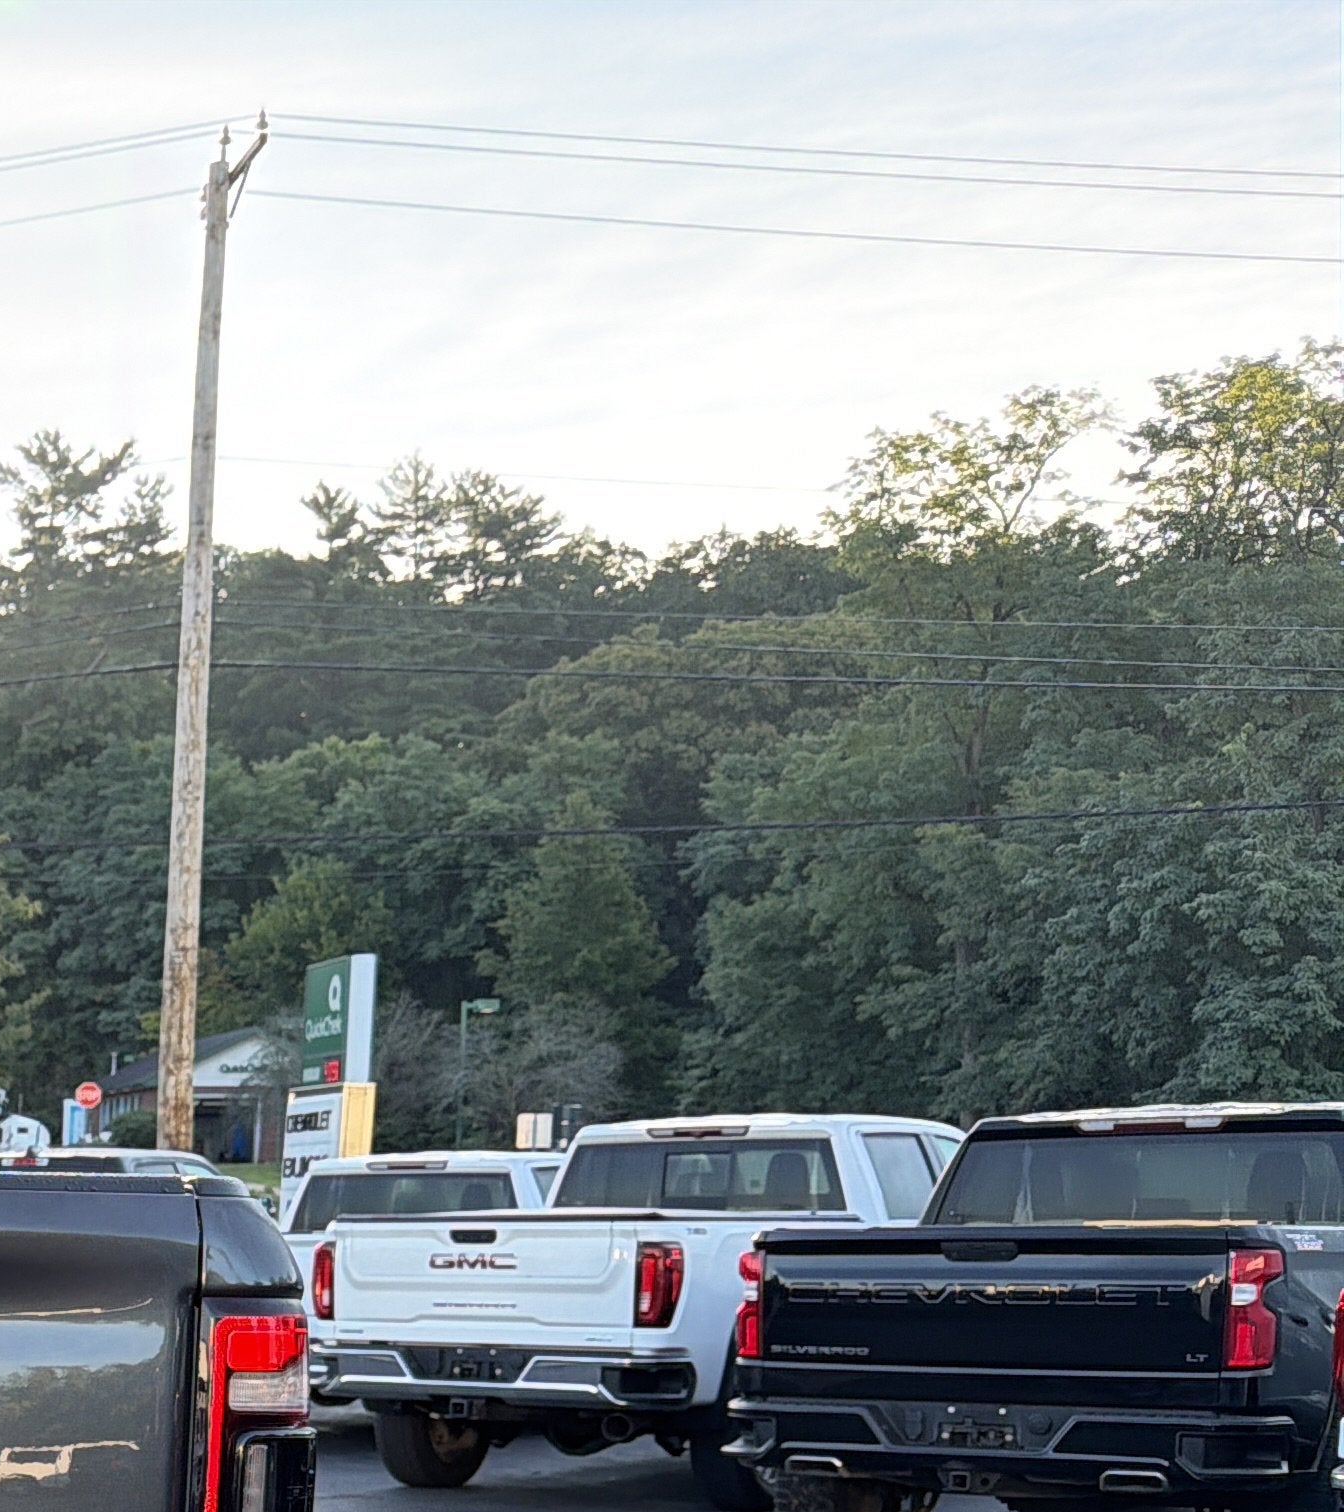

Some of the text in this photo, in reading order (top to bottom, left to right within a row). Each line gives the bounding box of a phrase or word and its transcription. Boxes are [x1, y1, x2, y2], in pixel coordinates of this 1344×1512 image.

[429, 1252, 518, 1270] GMC
[787, 1281, 1189, 1307] CHEVROLET
[770, 1344, 871, 1357] SILVERADO
[1185, 1352, 1210, 1364] LT
